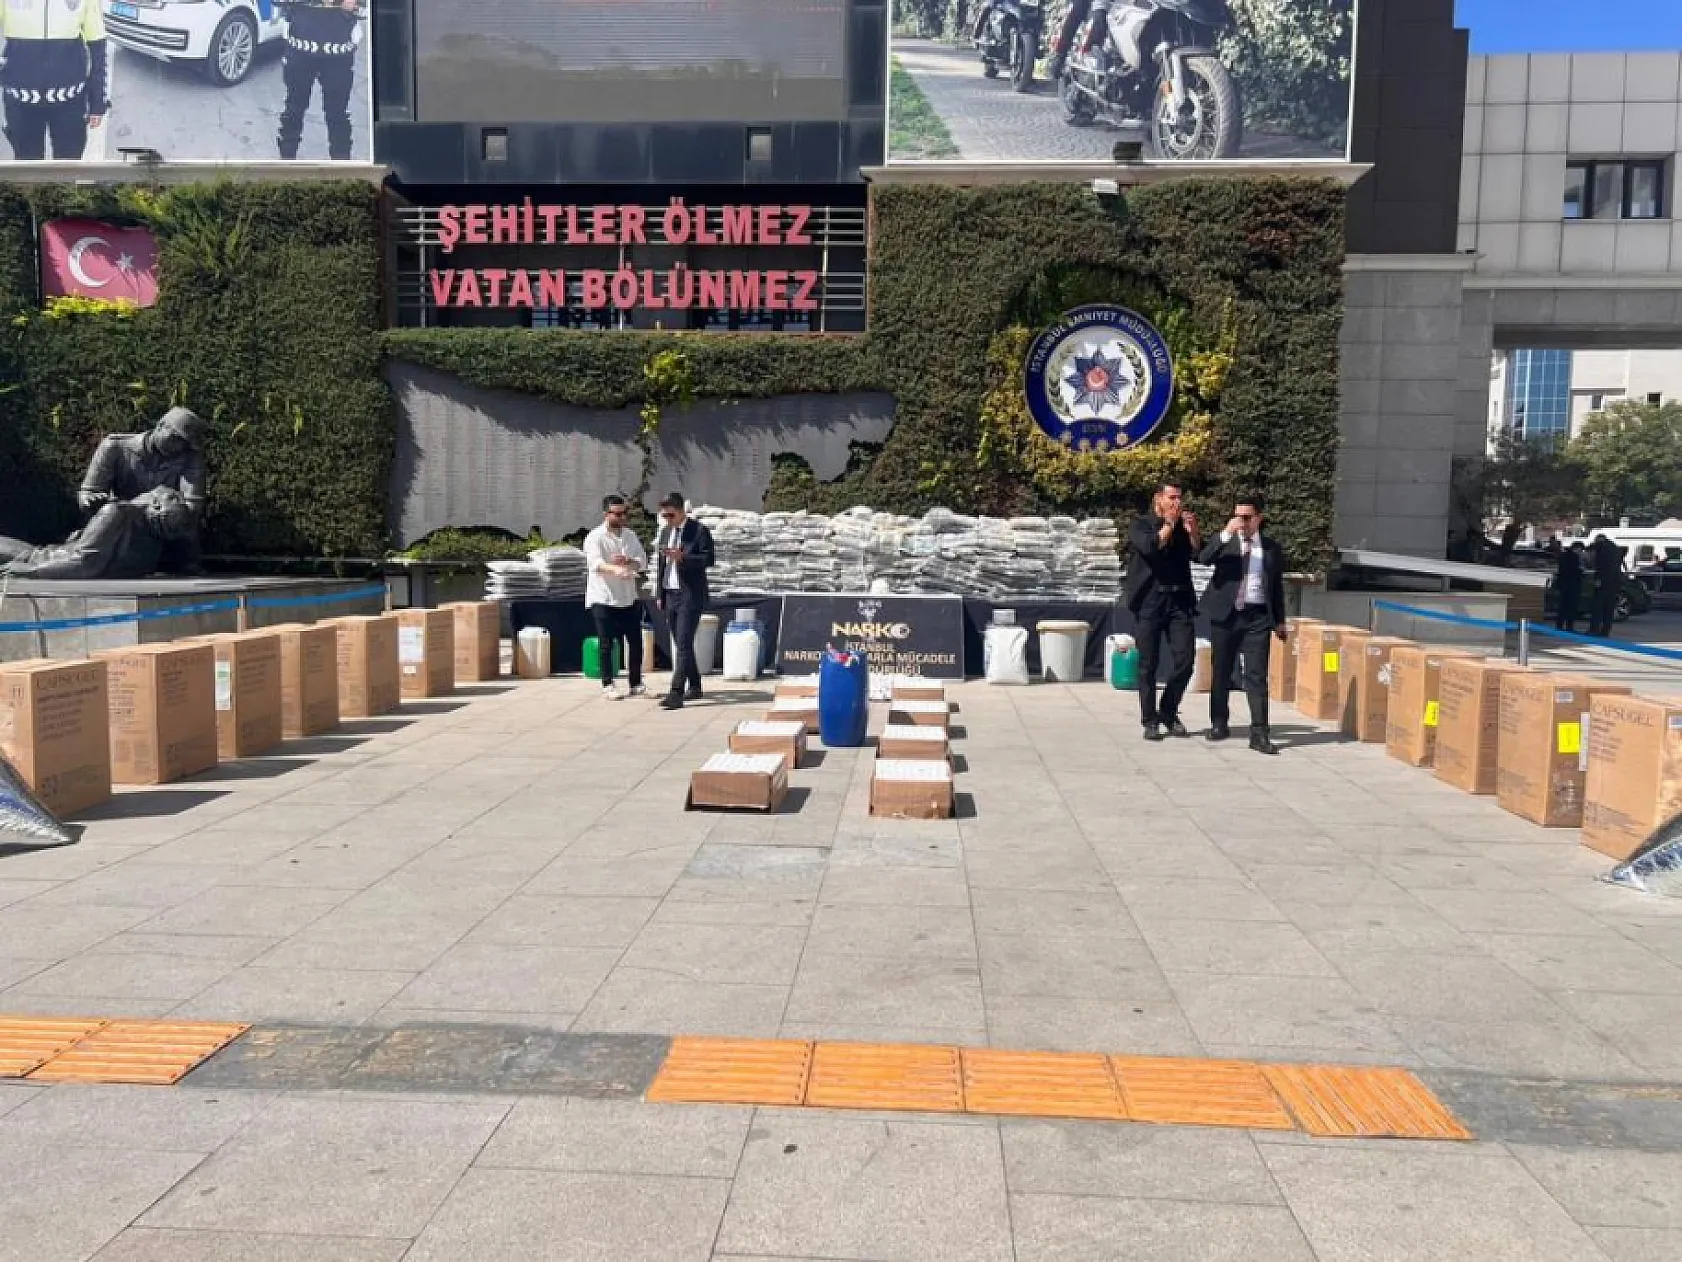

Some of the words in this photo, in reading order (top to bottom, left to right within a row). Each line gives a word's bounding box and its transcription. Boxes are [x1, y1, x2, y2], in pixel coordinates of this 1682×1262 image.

[437, 196, 646, 253] ŞEHİTLER
[663, 196, 811, 245] ÖLMEZ
[431, 267, 566, 307] VATAN
[582, 261, 818, 310] BÖLÜNMEZ
